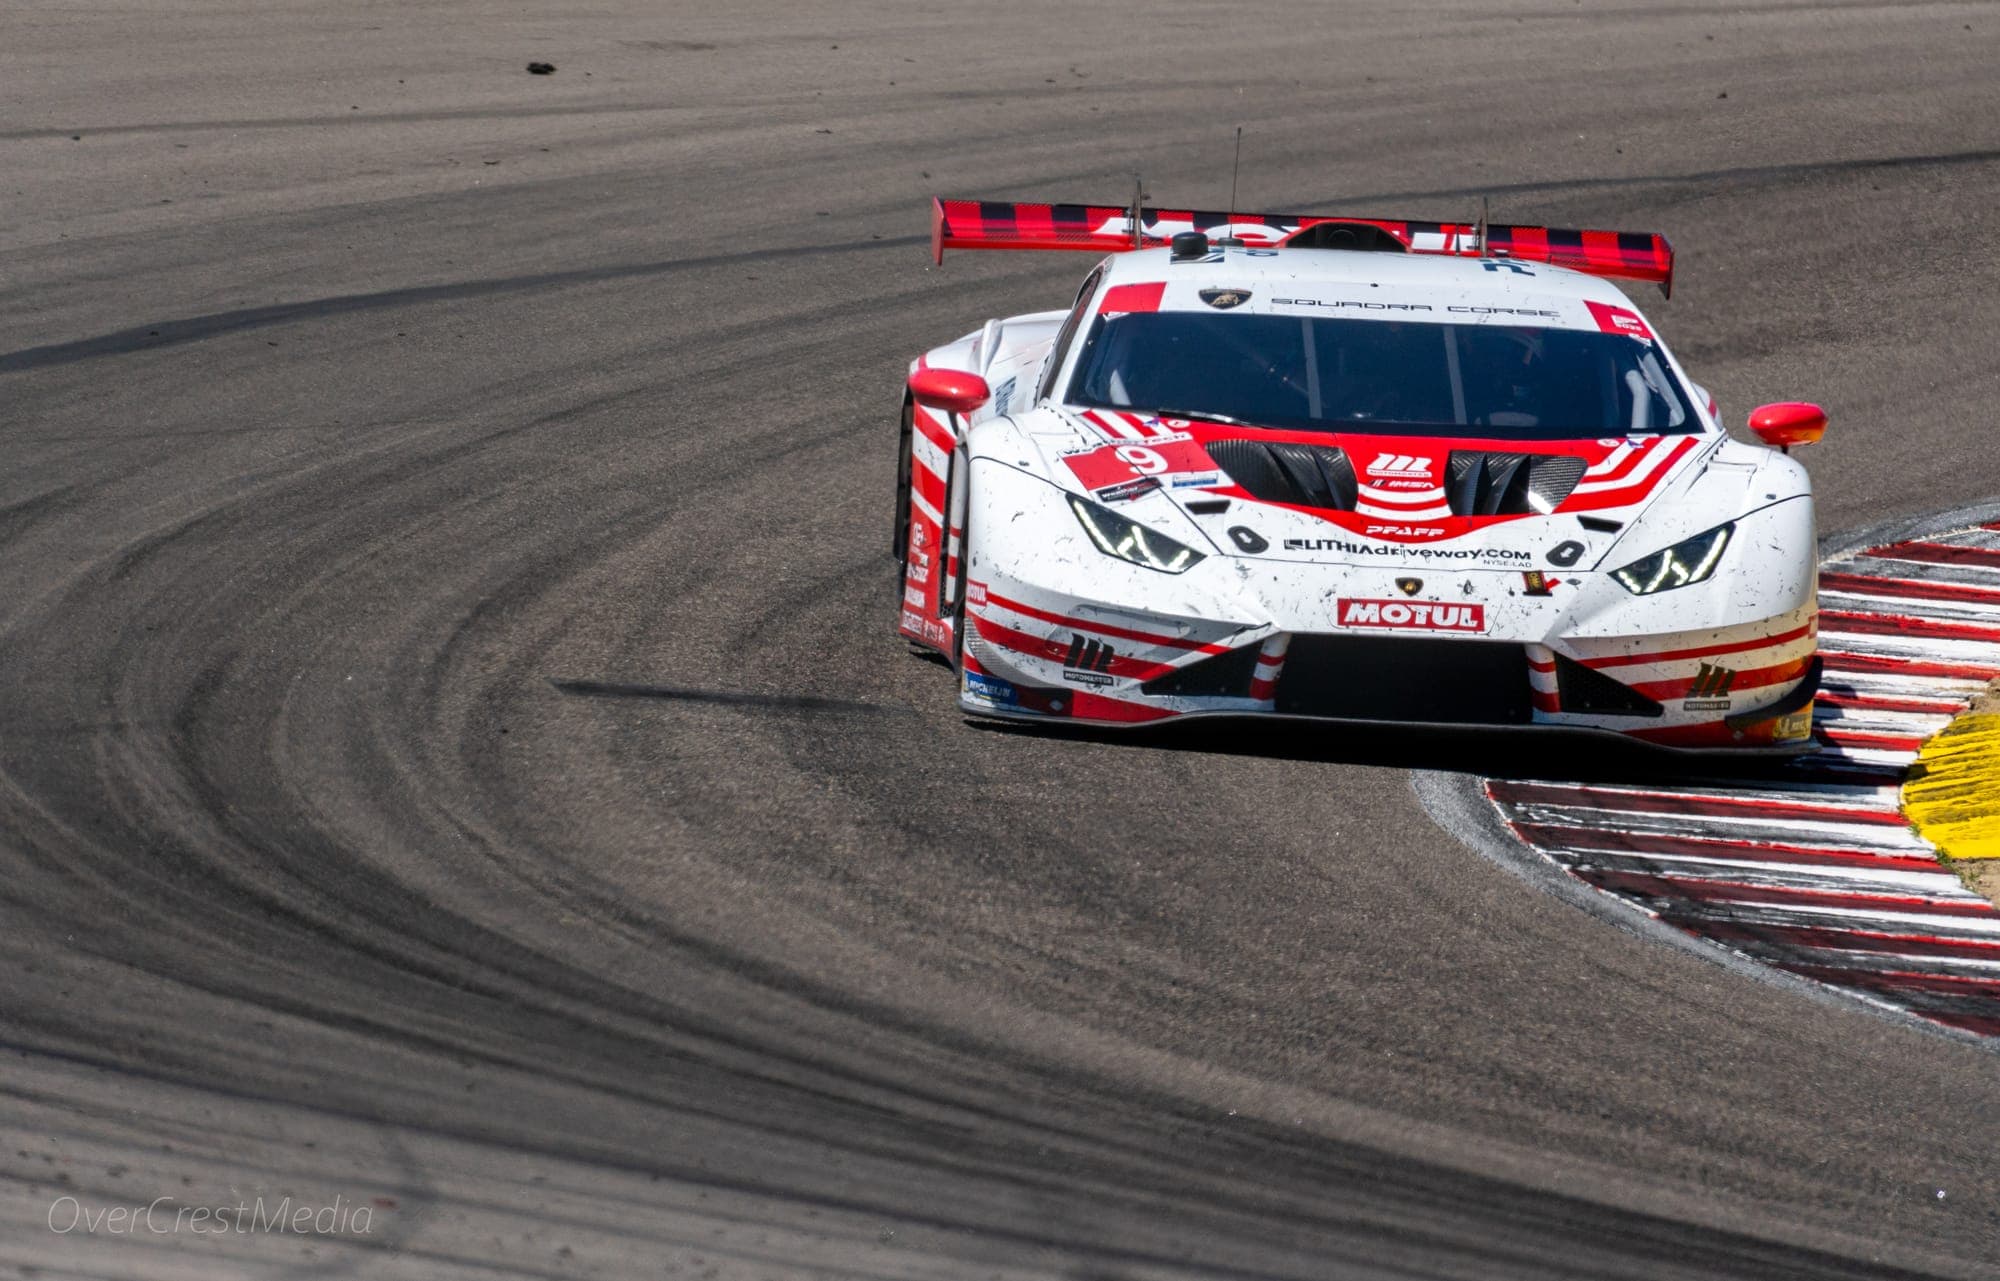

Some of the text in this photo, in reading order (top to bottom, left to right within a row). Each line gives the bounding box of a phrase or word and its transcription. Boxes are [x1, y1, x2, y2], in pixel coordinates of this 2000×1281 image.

[1271, 297, 1561, 318] SQUADRA CORSE
[1115, 445, 1168, 475] 9
[1366, 525, 1445, 537] PFAFF
[1343, 602, 1479, 627] MOTUL
